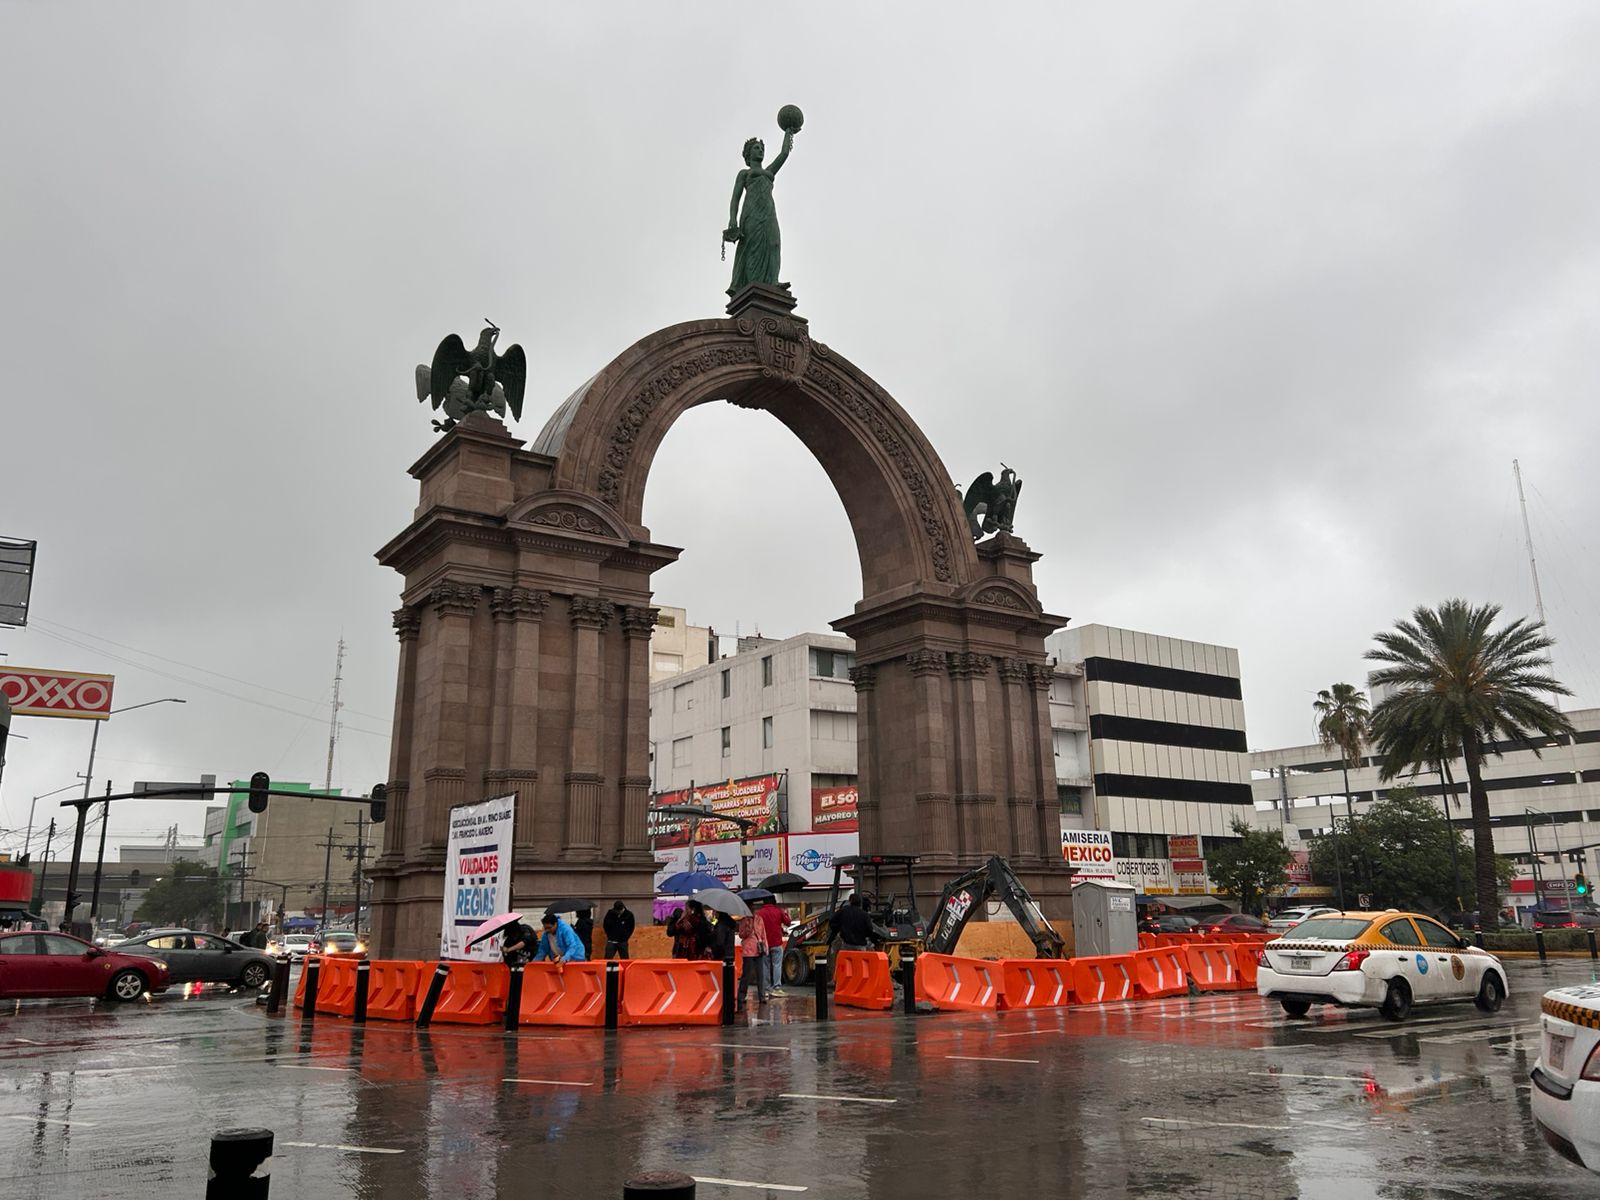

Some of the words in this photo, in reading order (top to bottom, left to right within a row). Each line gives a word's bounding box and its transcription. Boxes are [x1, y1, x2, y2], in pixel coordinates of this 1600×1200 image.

[770, 336, 796, 356] 1810
[0, 676, 108, 709] OXXO
[711, 800, 740, 811] HAMARRAS
[743, 797, 761, 807] PANTS
[821, 795, 835, 808] EL
[738, 806, 770, 818] CONJUNTOS
[815, 811, 852, 824] MAYOREO
[1062, 832, 1110, 845] AMISERIA
[1116, 862, 1160, 875] COBERTORES
[1161, 863, 1167, 875] Y
[456, 887, 497, 917] REGIAS
